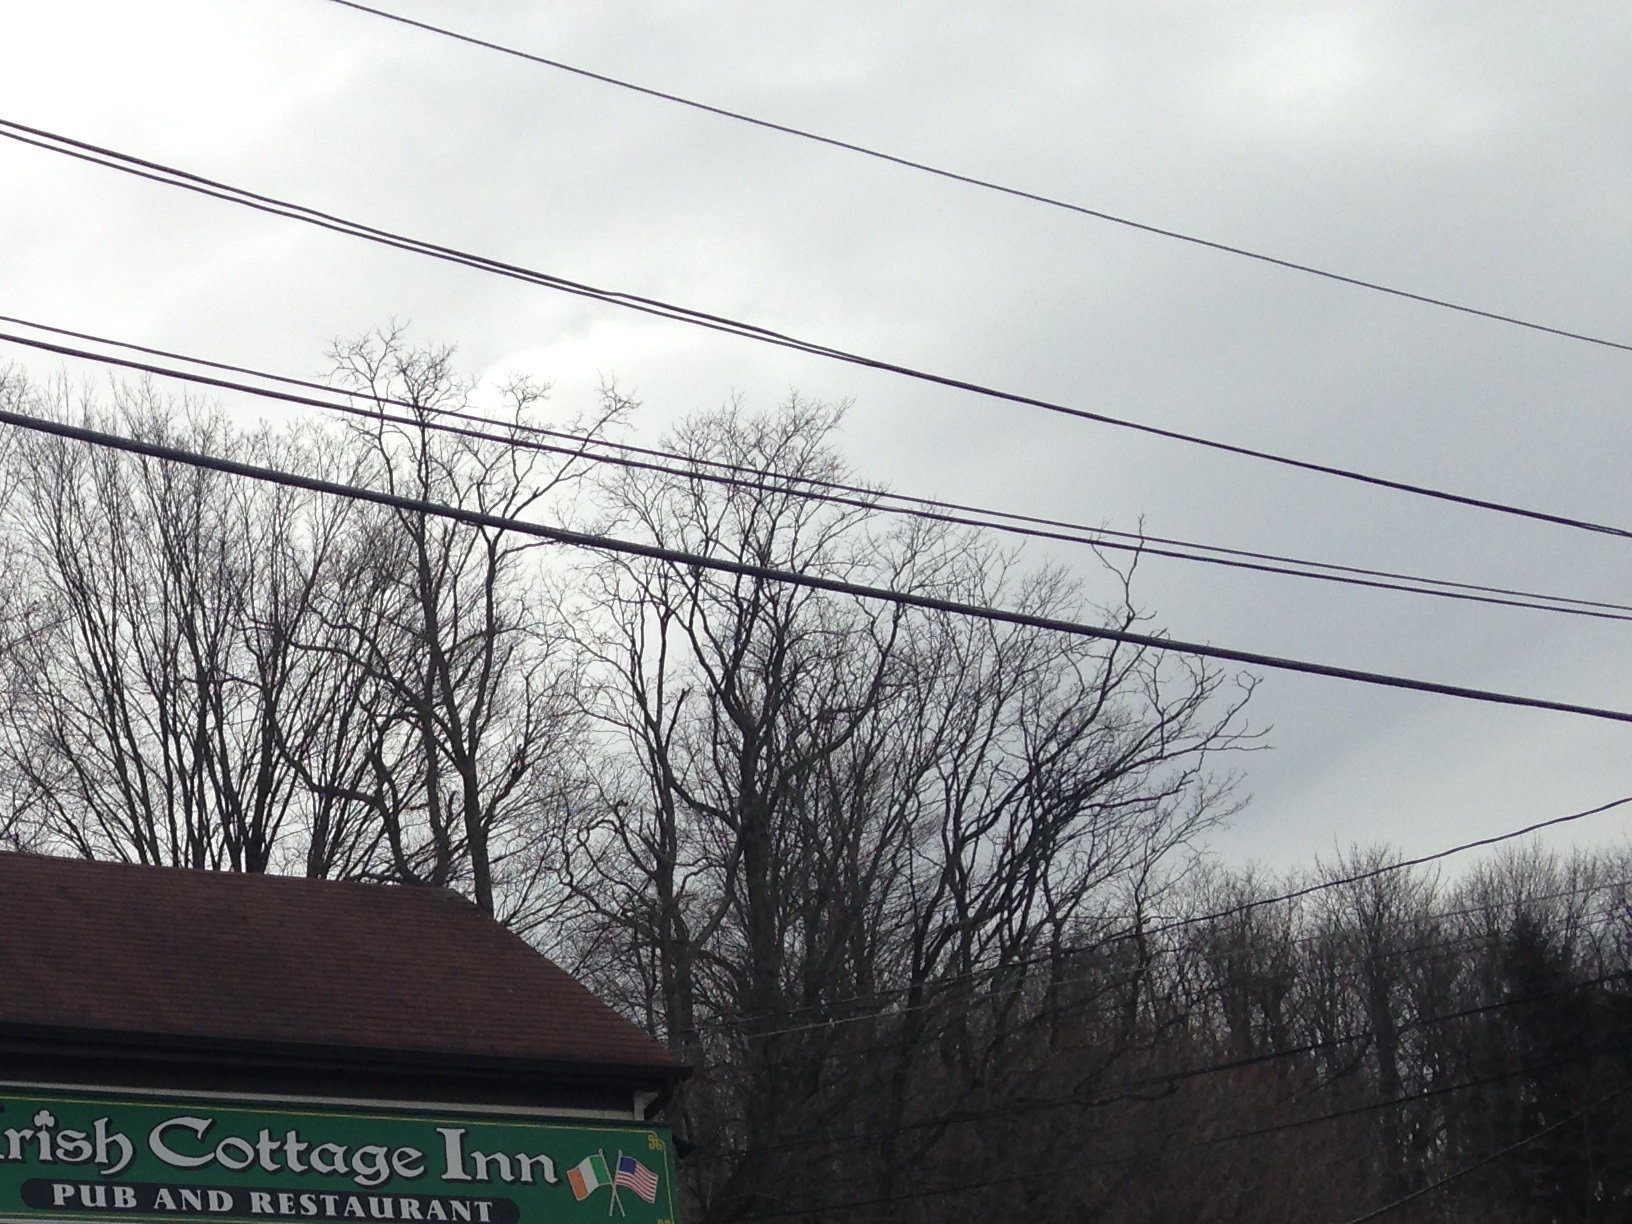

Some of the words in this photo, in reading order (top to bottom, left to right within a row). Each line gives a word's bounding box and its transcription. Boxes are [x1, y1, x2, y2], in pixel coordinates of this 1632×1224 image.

[148, 1116, 426, 1187] Cottage
[435, 1126, 560, 1185] Inn
[51, 1183, 138, 1209] PUB
[153, 1188, 235, 1213] AND
[248, 1191, 494, 1224] RESTAURANT
